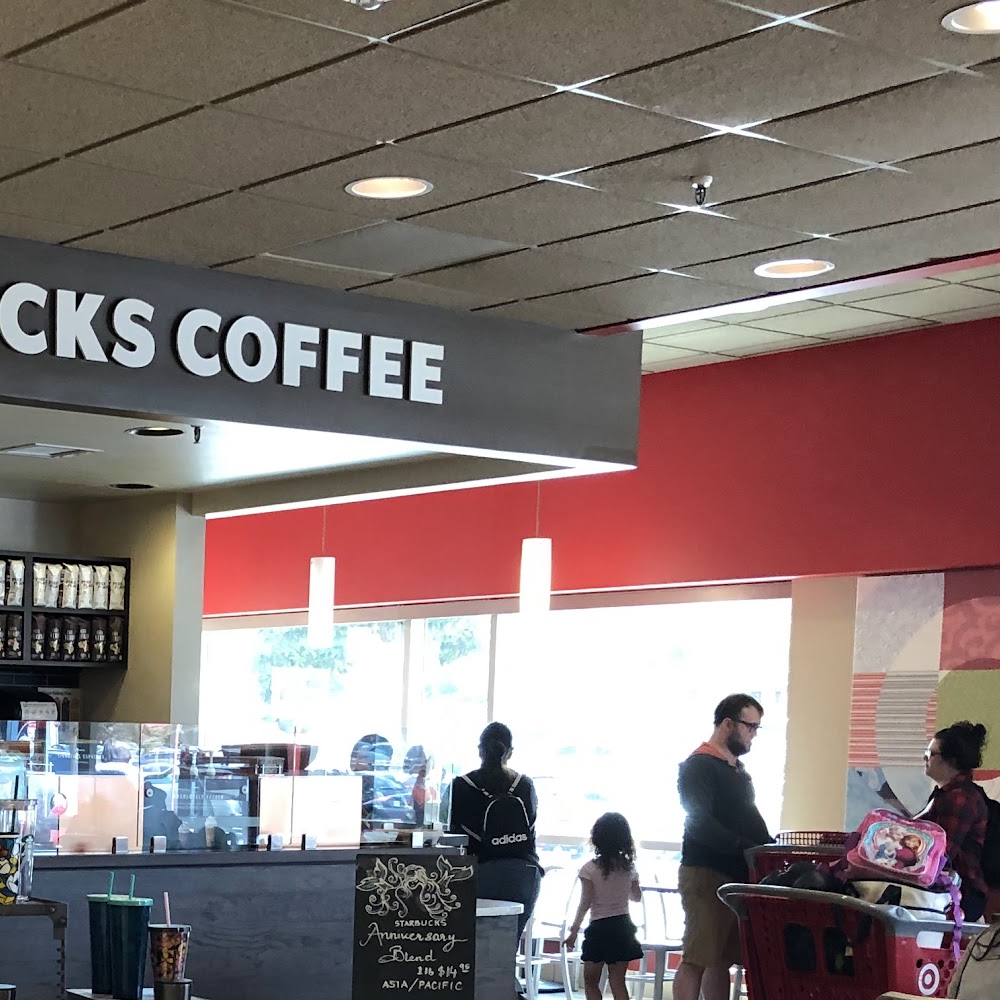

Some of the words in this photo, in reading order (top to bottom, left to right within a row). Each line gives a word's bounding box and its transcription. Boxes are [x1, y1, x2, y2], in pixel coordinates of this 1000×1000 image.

[176, 308, 446, 405] COFFEE
[491, 833, 528, 846] adidas
[394, 919, 448, 928] STARBUCKS
[359, 922, 468, 952] Anniversary
[378, 945, 437, 964] Blend
[382, 978, 463, 992] ASIA/PACIFIC
